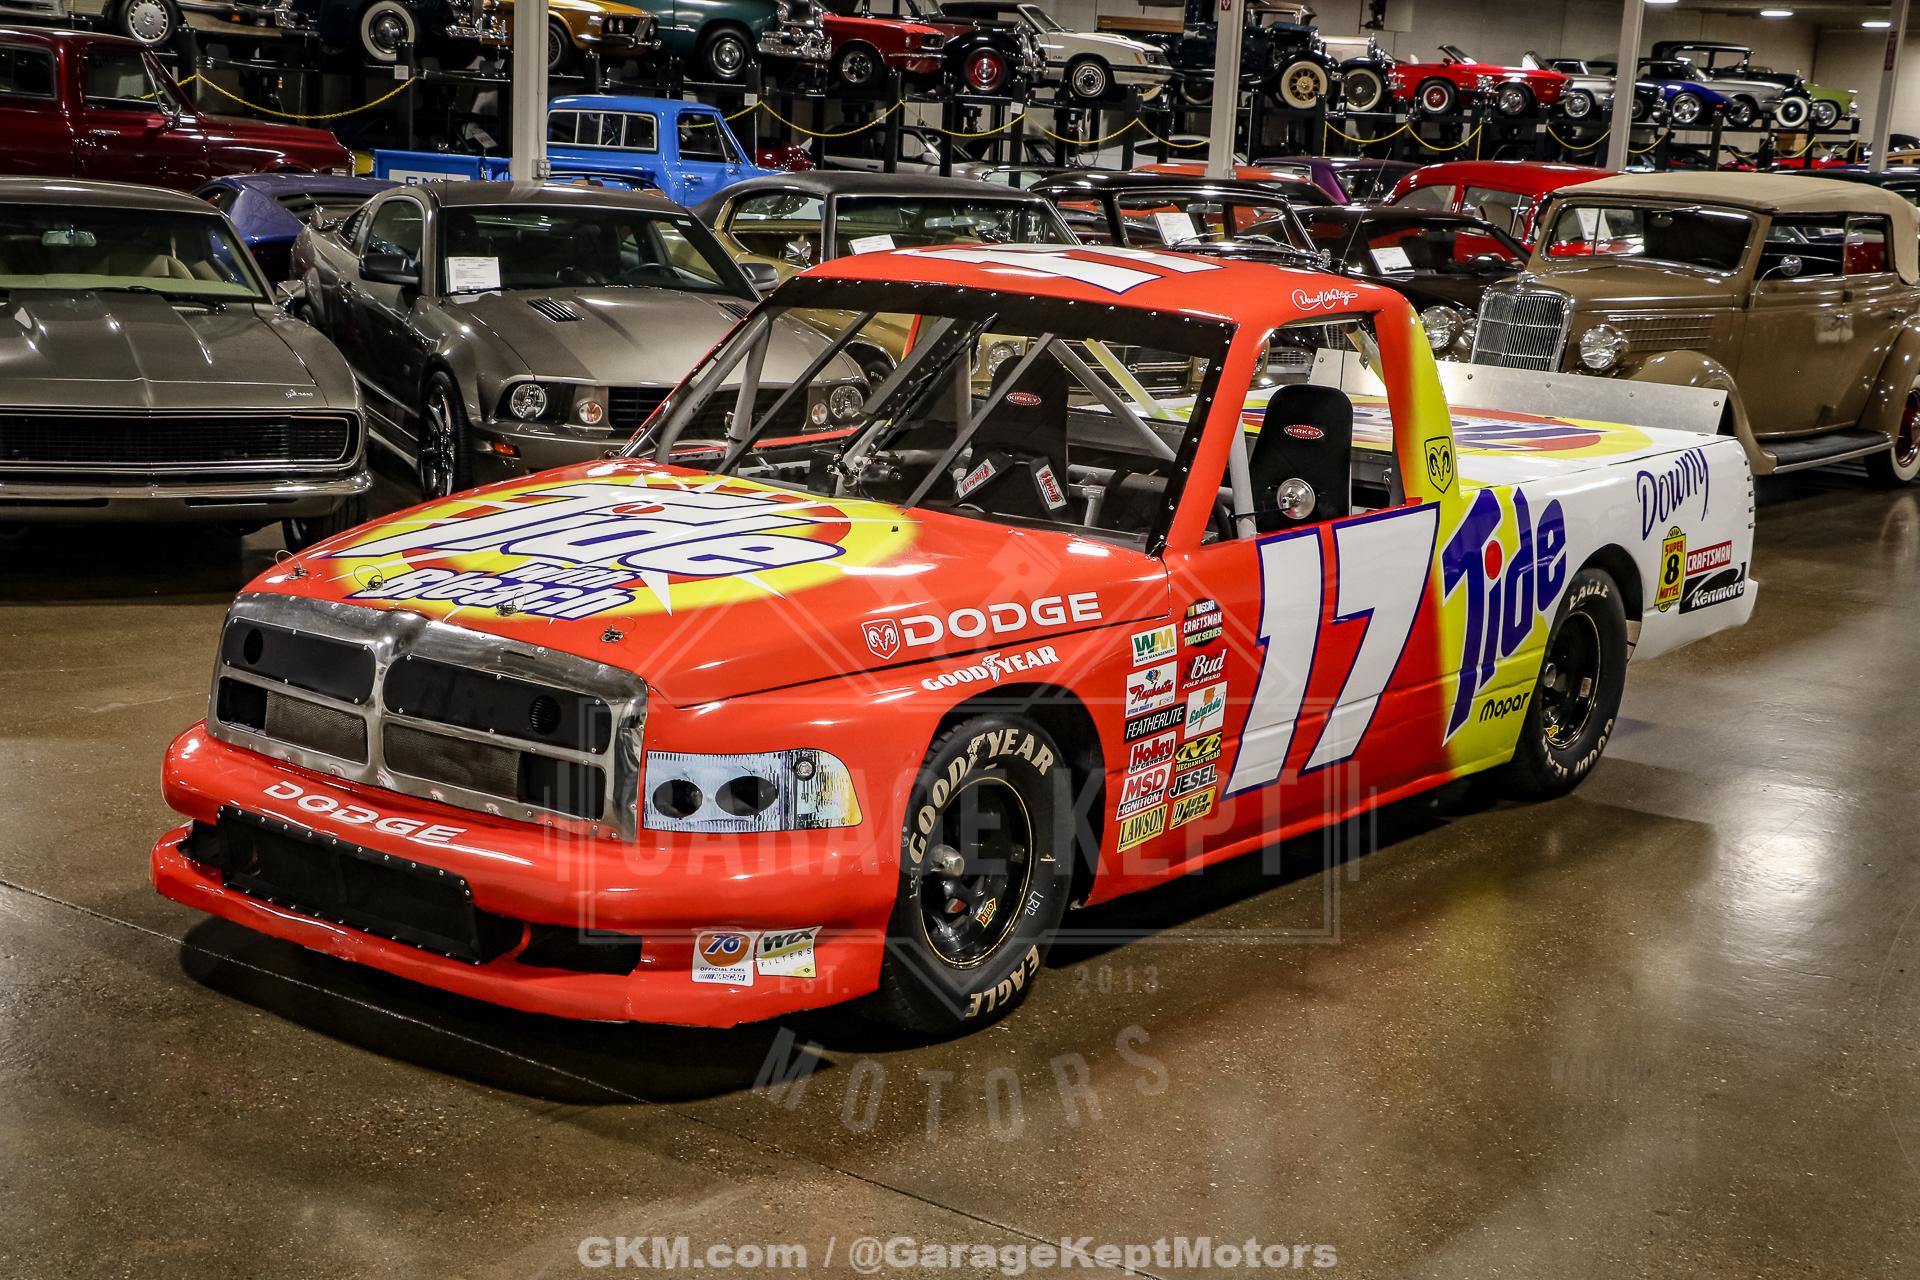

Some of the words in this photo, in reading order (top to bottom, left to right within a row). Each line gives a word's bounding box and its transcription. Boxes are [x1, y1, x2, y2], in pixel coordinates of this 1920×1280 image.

[1009, 395, 1038, 403] KIRKEY
[1287, 427, 1320, 436] KIRKEY
[1637, 448, 1709, 541] Downy
[320, 483, 848, 577] Tide
[1665, 541, 1684, 557] SUPER
[1687, 544, 1732, 572] CRAFTSMAN
[506, 562, 643, 589] with
[1664, 554, 1680, 585] 8
[342, 567, 638, 621] Bleach
[1658, 583, 1680, 600] MOTEL
[1691, 580, 1745, 608] Kenmore
[900, 591, 1103, 647] DODGE
[1183, 611, 1223, 634] CRAFTSMAN
[1442, 486, 1567, 747] Tide
[1134, 629, 1175, 656] WM
[1184, 632, 1202, 647] TRUCK
[1202, 626, 1223, 641] SERIES
[1190, 648, 1227, 680] Bud
[1221, 501, 1440, 801] 17
[920, 645, 1060, 691] GOODYEAR
[1182, 680, 1200, 689] POLE
[1126, 706, 1185, 739] FEATHERLITE
[1132, 739, 1174, 767] Holley
[1176, 758, 1205, 772] MECHANIX
[1205, 749, 1221, 762] WEAR
[1124, 768, 1166, 803] MSD
[1169, 764, 1217, 798] JESEL
[909, 728, 1055, 864] GOODYEAR
[1120, 792, 1161, 815] IGNITION
[263, 781, 468, 842] DODGE
[1120, 807, 1167, 845] LAWSON
[704, 935, 744, 955] 76
[764, 927, 818, 953] WIX
[761, 947, 812, 968] FILTERS
[966, 945, 1040, 1018] EAGLE
